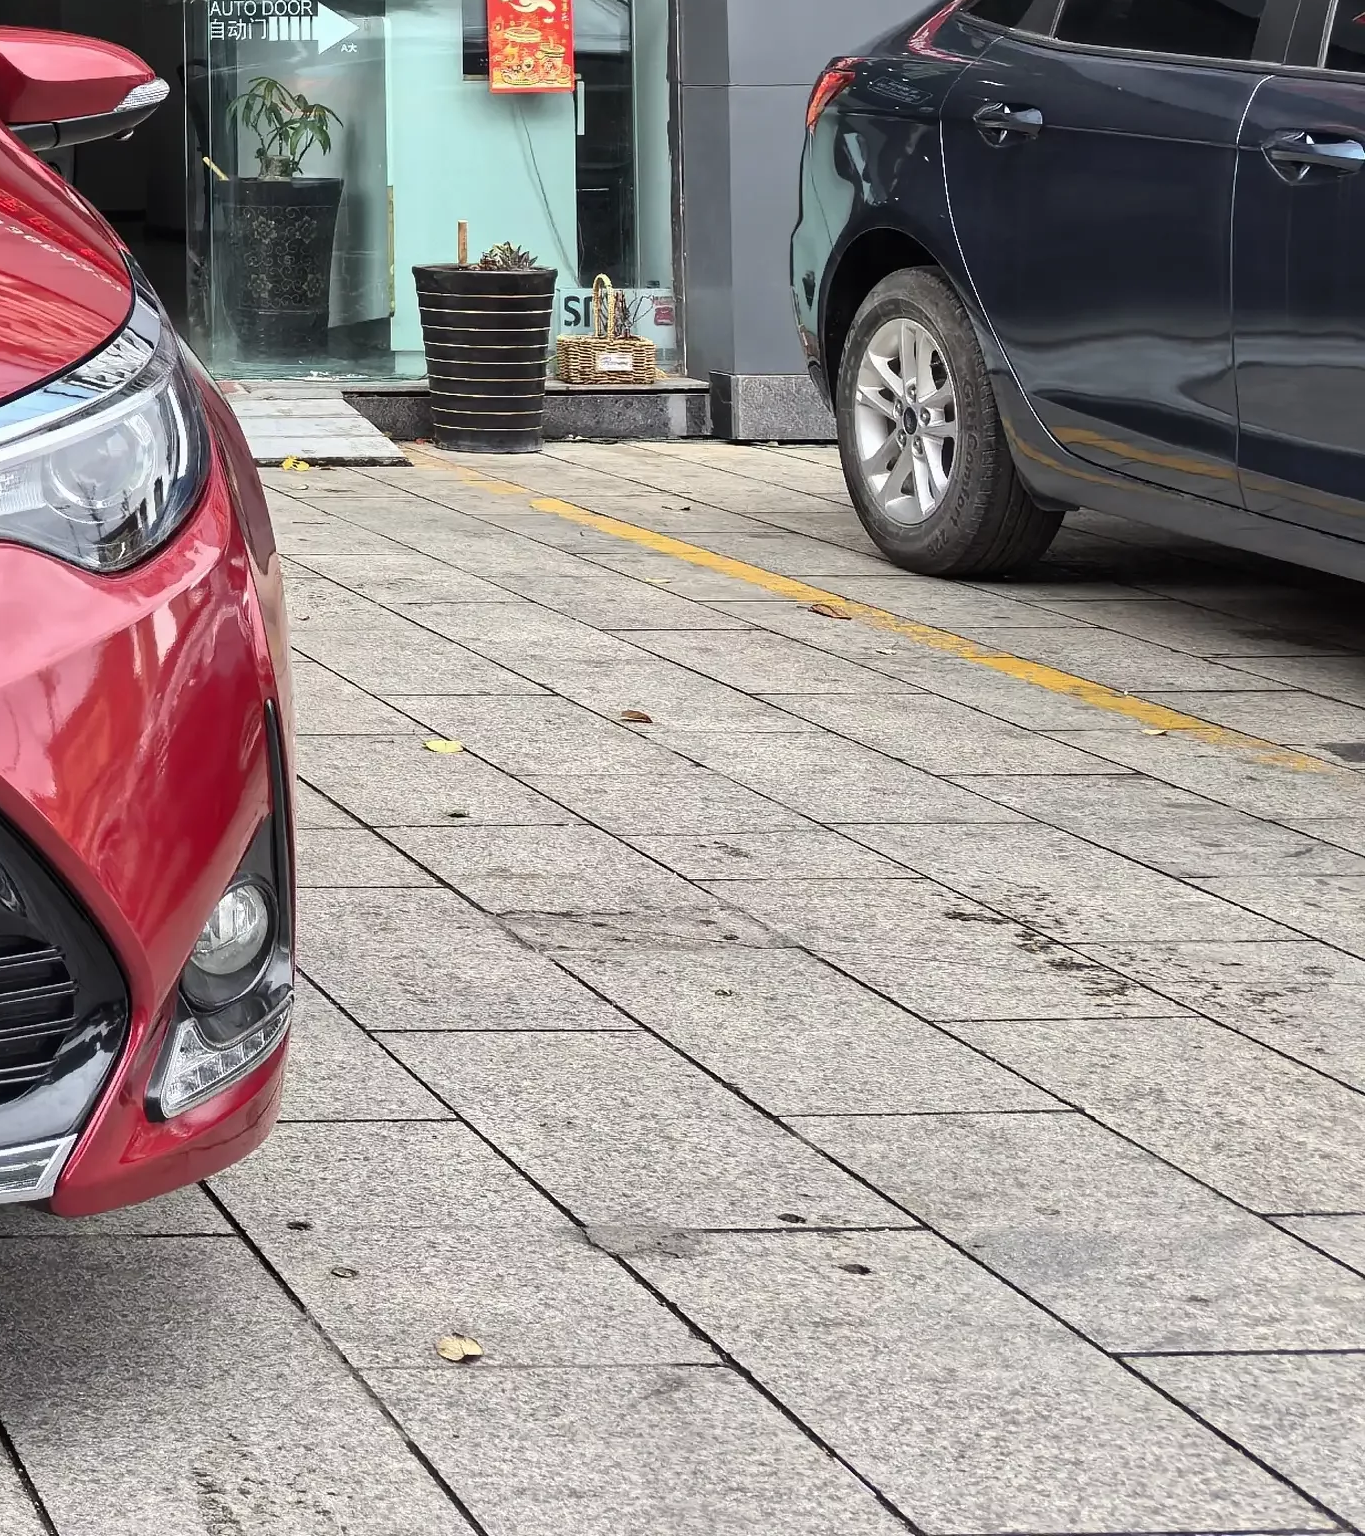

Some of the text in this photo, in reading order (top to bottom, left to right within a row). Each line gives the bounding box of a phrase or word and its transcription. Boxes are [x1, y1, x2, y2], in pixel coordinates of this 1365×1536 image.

[209, 0, 314, 16] AUTO DOOR
[209, 18, 267, 41] 自动门
